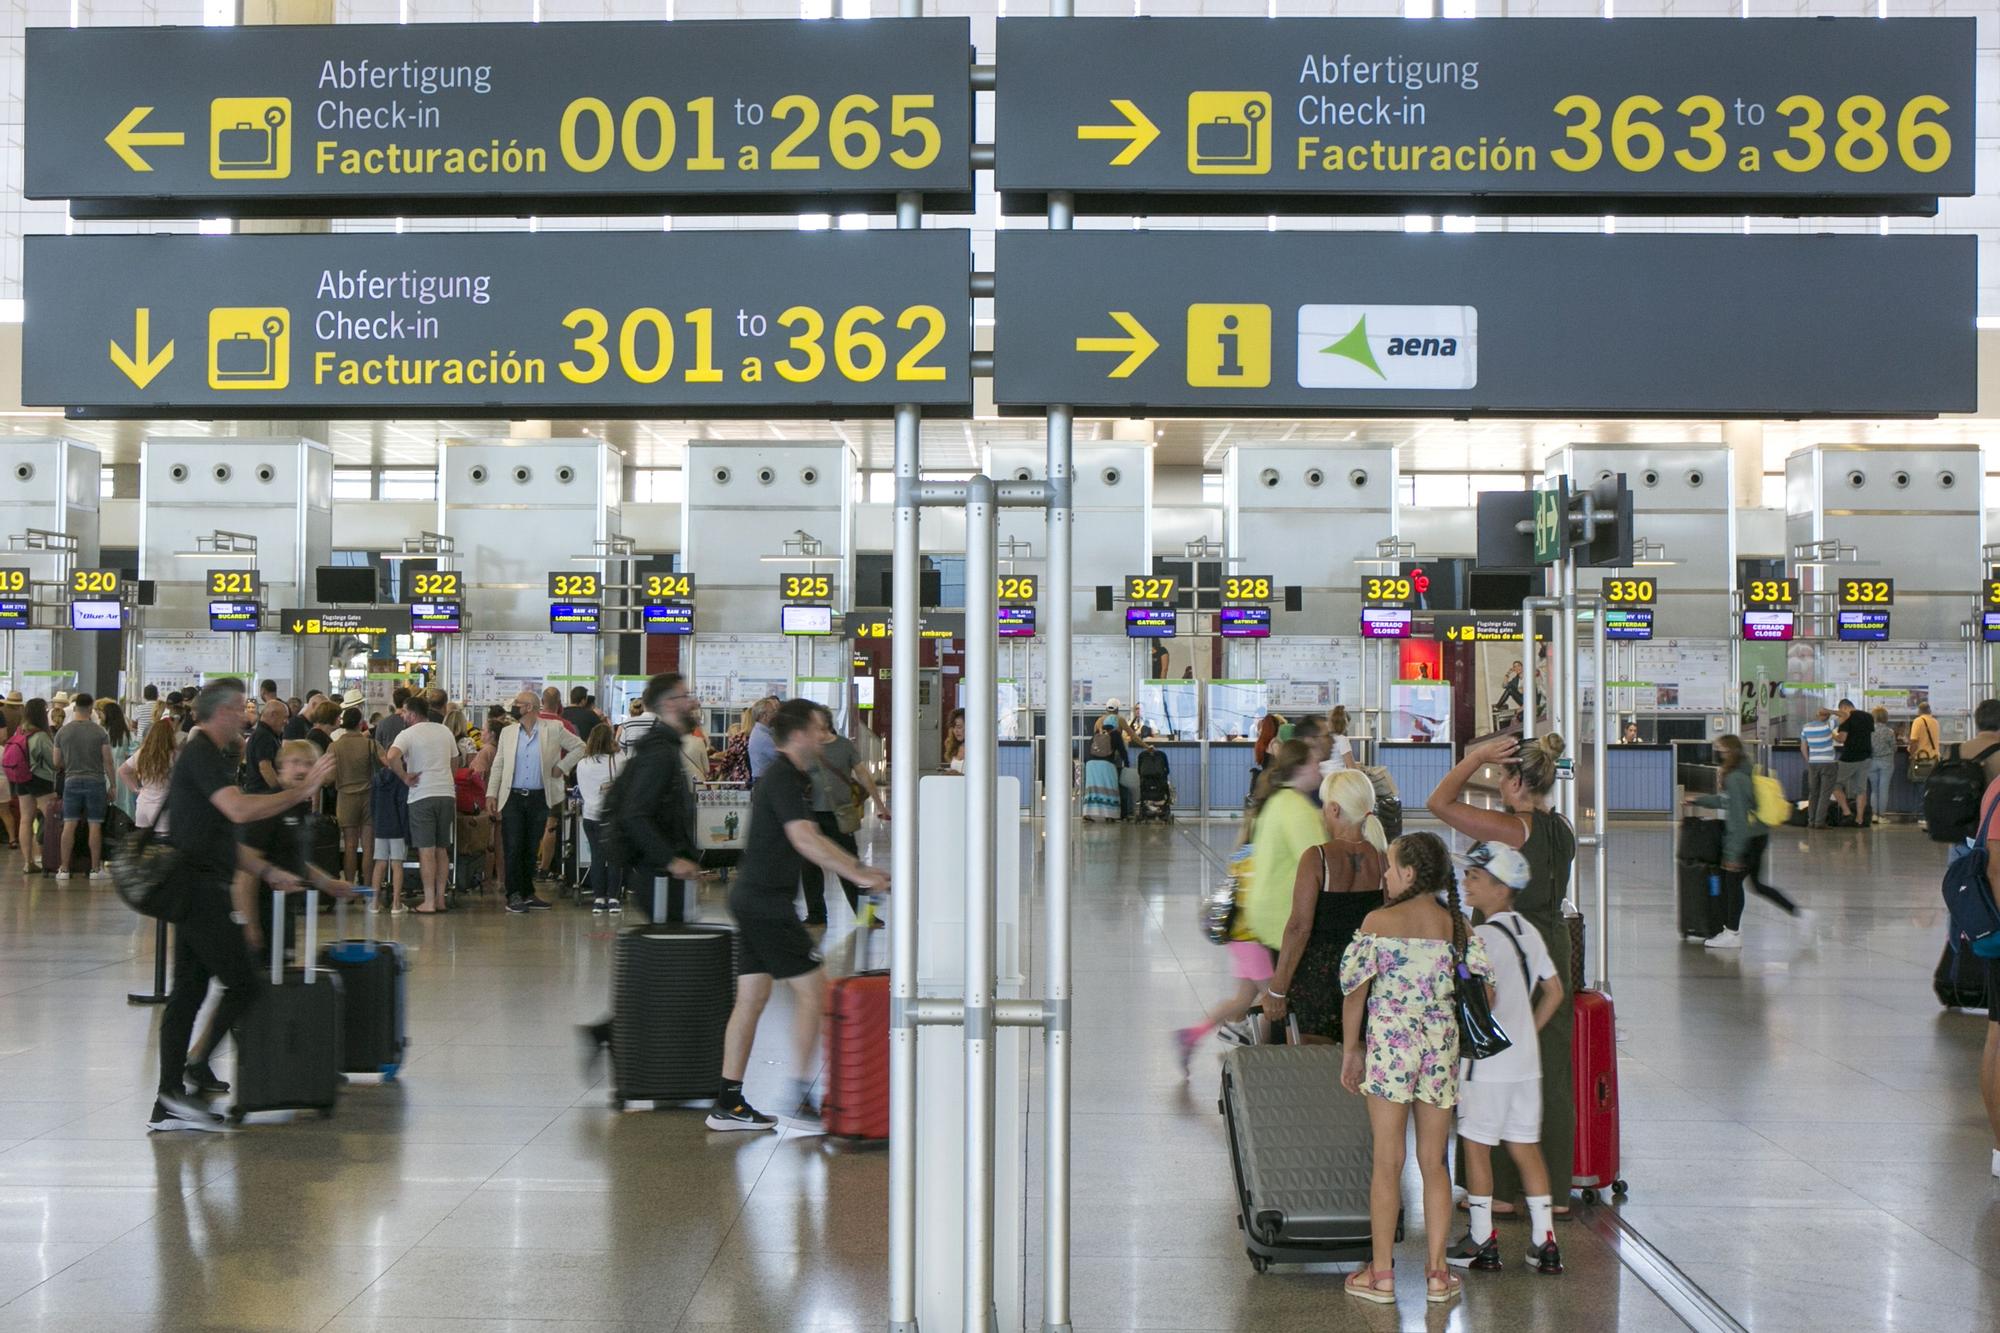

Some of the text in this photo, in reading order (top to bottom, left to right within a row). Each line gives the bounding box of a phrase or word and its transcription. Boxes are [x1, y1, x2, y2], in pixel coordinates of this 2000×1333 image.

[318, 60, 492, 94] Abfertigung
[1299, 54, 1480, 90] Abfertigung
[317, 99, 440, 130] Check-in
[1298, 94, 1426, 126] Check-in
[560, 94, 942, 173] 001 to 265
[1551, 94, 1952, 174] 363 to 386
[316, 141, 546, 174] Facturación
[739, 147, 759, 170] a
[1298, 137, 1536, 172] Facturación
[1738, 148, 1760, 172] a
[316, 269, 491, 304] Abfertigung
[315, 310, 439, 341] Check-in
[558, 305, 947, 385] 301 to 362
[1387, 338, 1457, 356] aena
[314, 351, 546, 385] Facturación
[741, 357, 762, 383] a
[74, 572, 116, 592] 320
[212, 573, 253, 593] 321
[414, 575, 456, 595] 322
[554, 576, 596, 596] 323
[648, 576, 690, 597] 324
[786, 577, 829, 598] 325
[1131, 579, 1174, 599] 327
[1226, 579, 1270, 599] 328
[1367, 579, 1411, 600] 329
[1609, 581, 1653, 602] 330
[1750, 581, 1792, 602] 331
[1845, 582, 1889, 603] 332
[356, 626, 387, 634] embarque
[922, 631, 953, 639] embarque
[1477, 632, 1502, 640] Puertas
